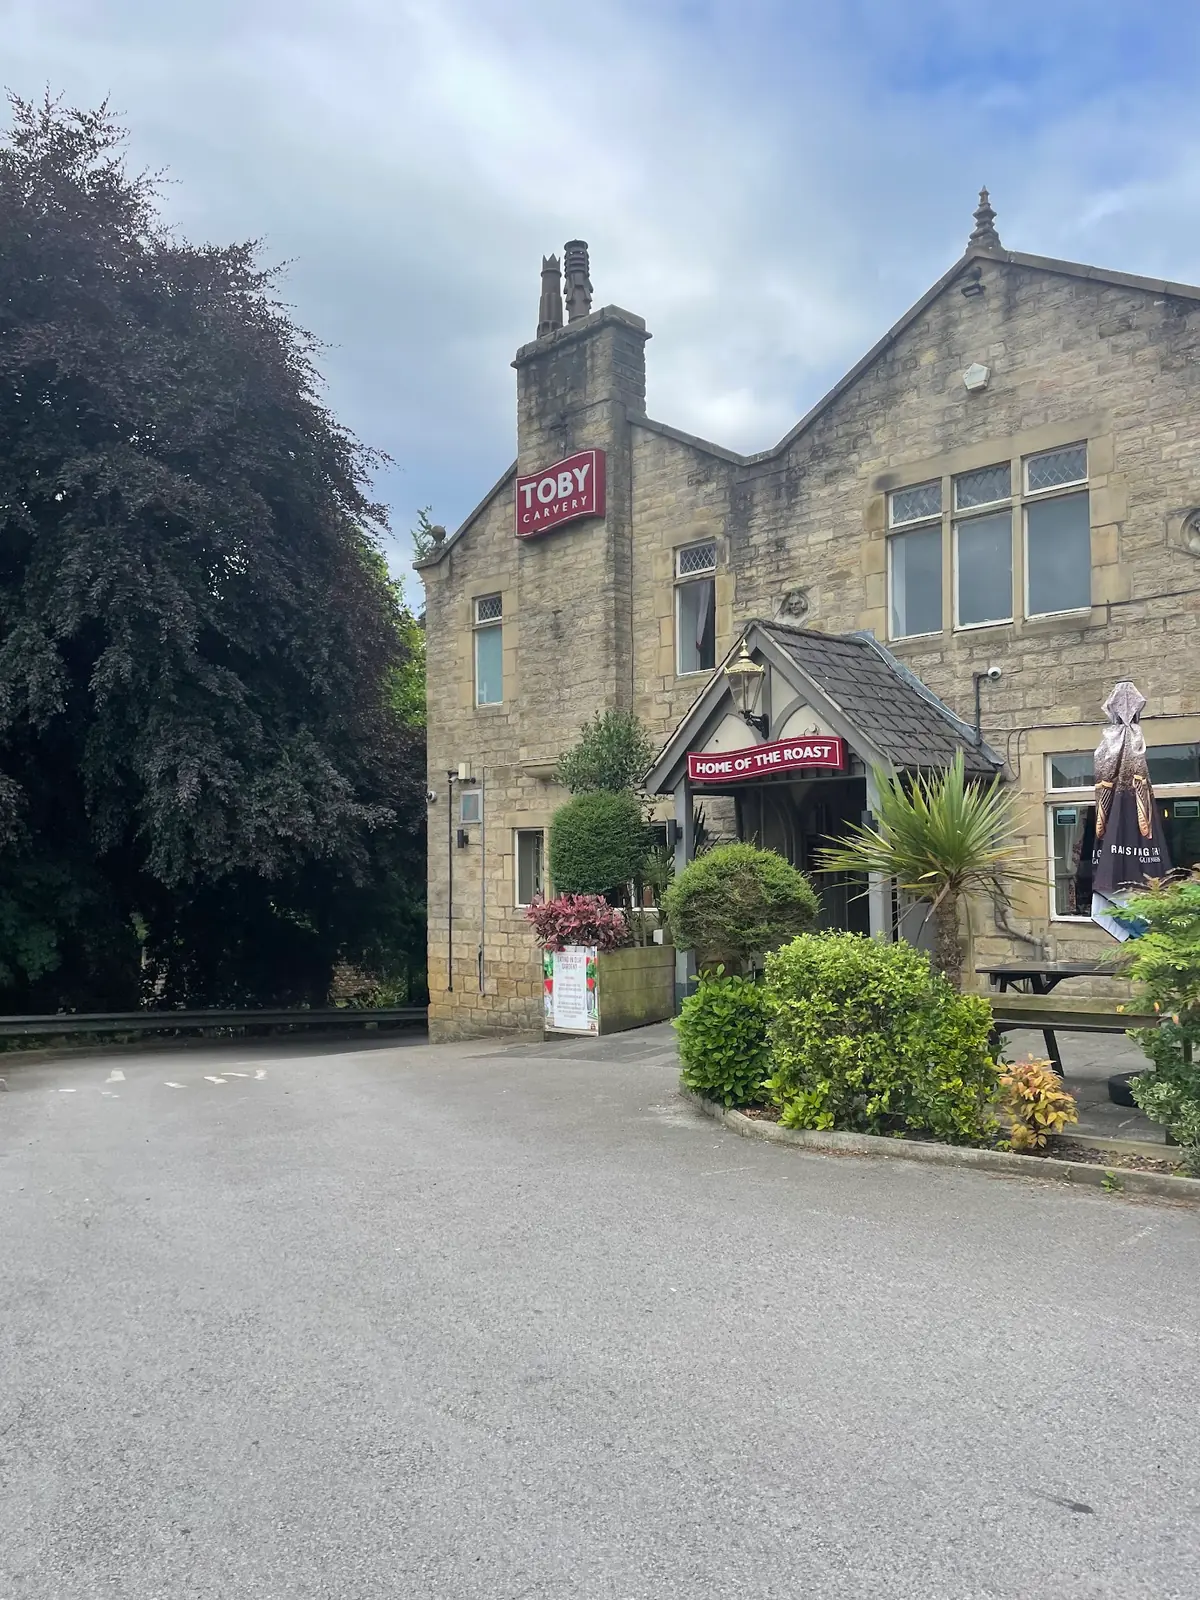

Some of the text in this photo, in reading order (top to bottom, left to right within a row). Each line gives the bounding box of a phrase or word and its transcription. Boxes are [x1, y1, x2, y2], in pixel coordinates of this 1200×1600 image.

[520, 463, 590, 509] TOBY
[523, 495, 587, 523] CARVERY
[696, 746, 832, 774] HOME OF THE ROAST
